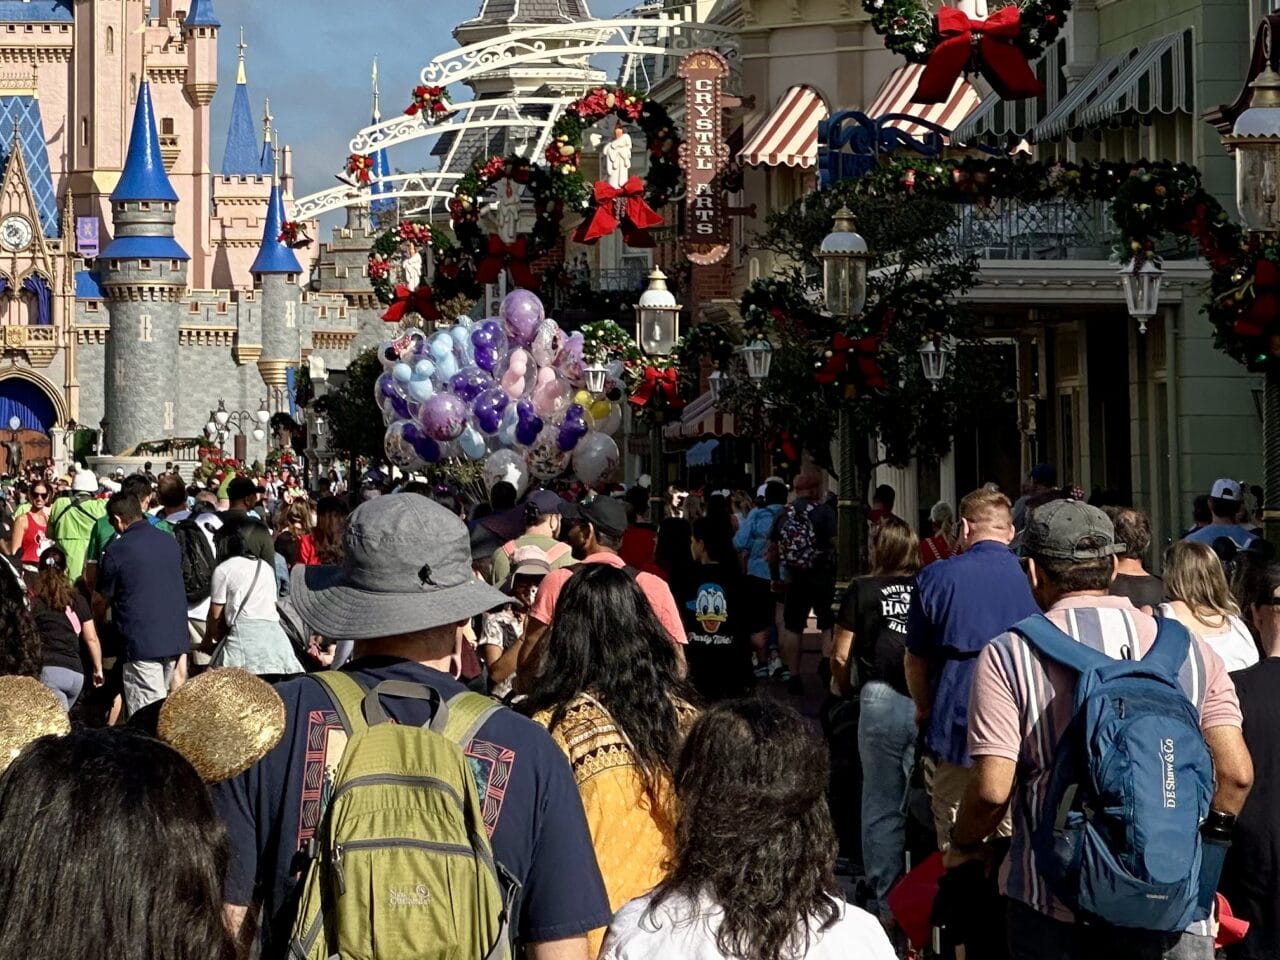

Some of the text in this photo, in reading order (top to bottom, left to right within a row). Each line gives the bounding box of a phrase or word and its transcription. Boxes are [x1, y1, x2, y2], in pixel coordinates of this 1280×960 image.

[694, 79, 714, 235] CRYSTAL ARTS
[881, 585, 906, 596] NORTH
[688, 631, 713, 645] Party
